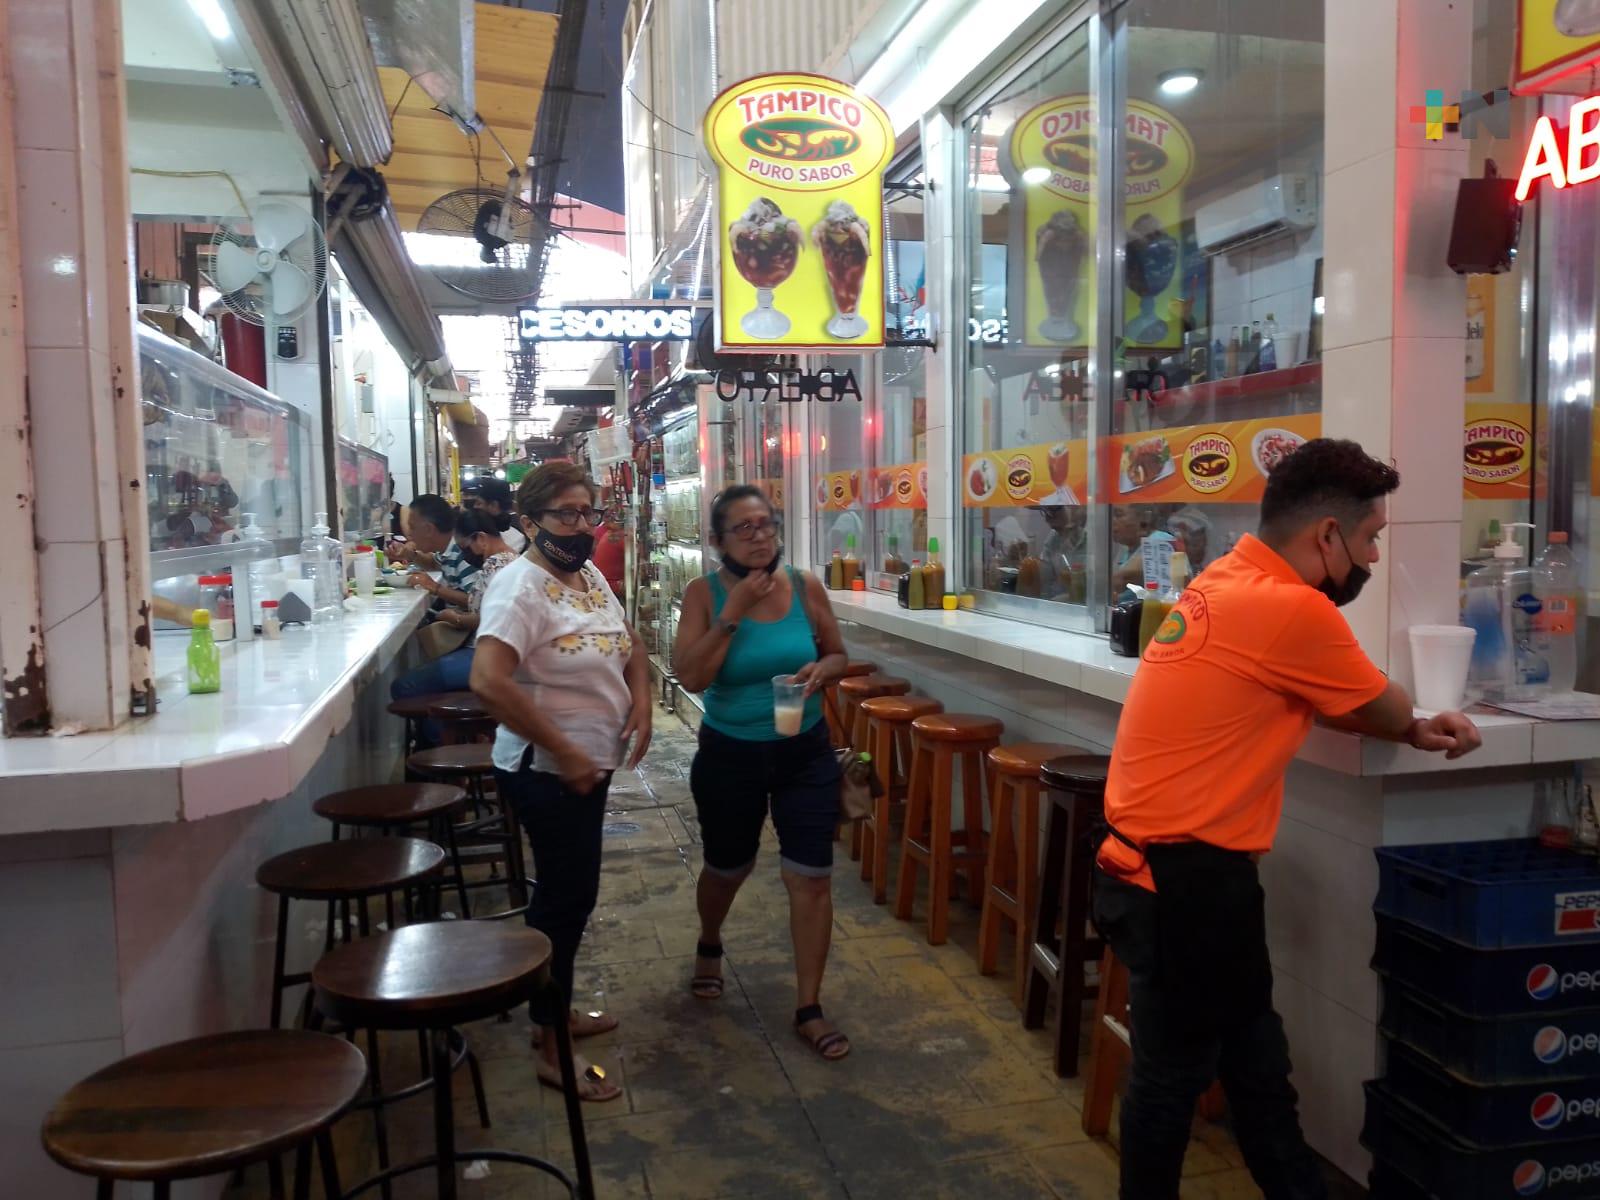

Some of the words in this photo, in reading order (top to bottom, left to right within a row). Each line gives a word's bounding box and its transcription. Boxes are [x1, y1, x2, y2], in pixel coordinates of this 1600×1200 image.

[738, 91, 861, 127] TAMPICO
[748, 158, 794, 180] PURO
[799, 162, 854, 182] SABOR
[1464, 425, 1525, 445] AMPICO
[1190, 438, 1230, 457] TAMPICO
[1489, 464, 1520, 479] SABOR
